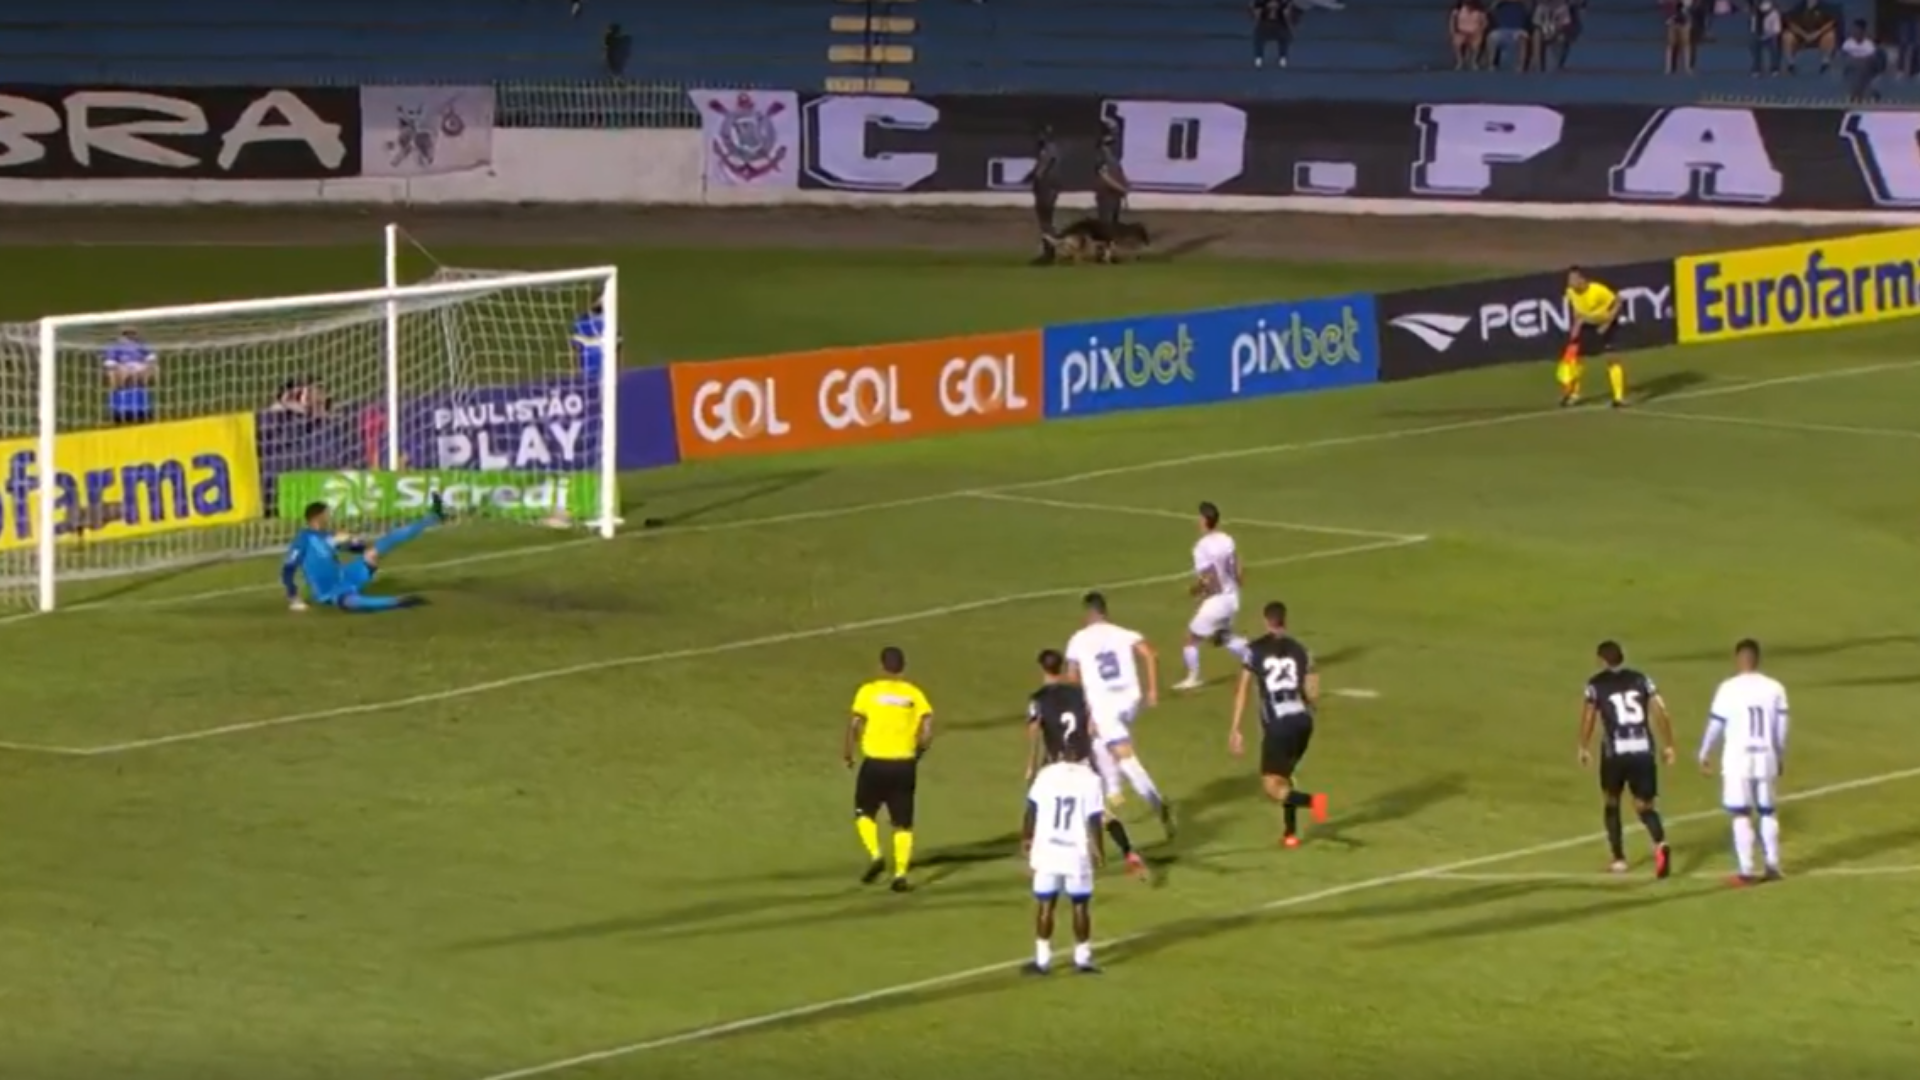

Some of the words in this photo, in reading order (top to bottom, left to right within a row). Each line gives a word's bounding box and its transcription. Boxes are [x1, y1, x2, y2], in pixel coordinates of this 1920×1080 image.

[1480, 285, 1670, 341] PENTY
[1695, 249, 1920, 334] Eurofarm
[1061, 323, 1195, 411] pixbet
[1231, 306, 1361, 393] pixbet
[434, 390, 583, 431] PAULISTÃO
[693, 377, 790, 442] GOL
[818, 364, 911, 429] GOL
[939, 354, 1028, 416] GOL
[438, 420, 582, 469] PLAY
[0, 448, 233, 540] farma
[395, 476, 570, 509] Sicredi
[1263, 656, 1298, 693] 23
[1609, 691, 1645, 725] 15
[1747, 705, 1766, 738] 11
[1054, 796, 1077, 830] 17
